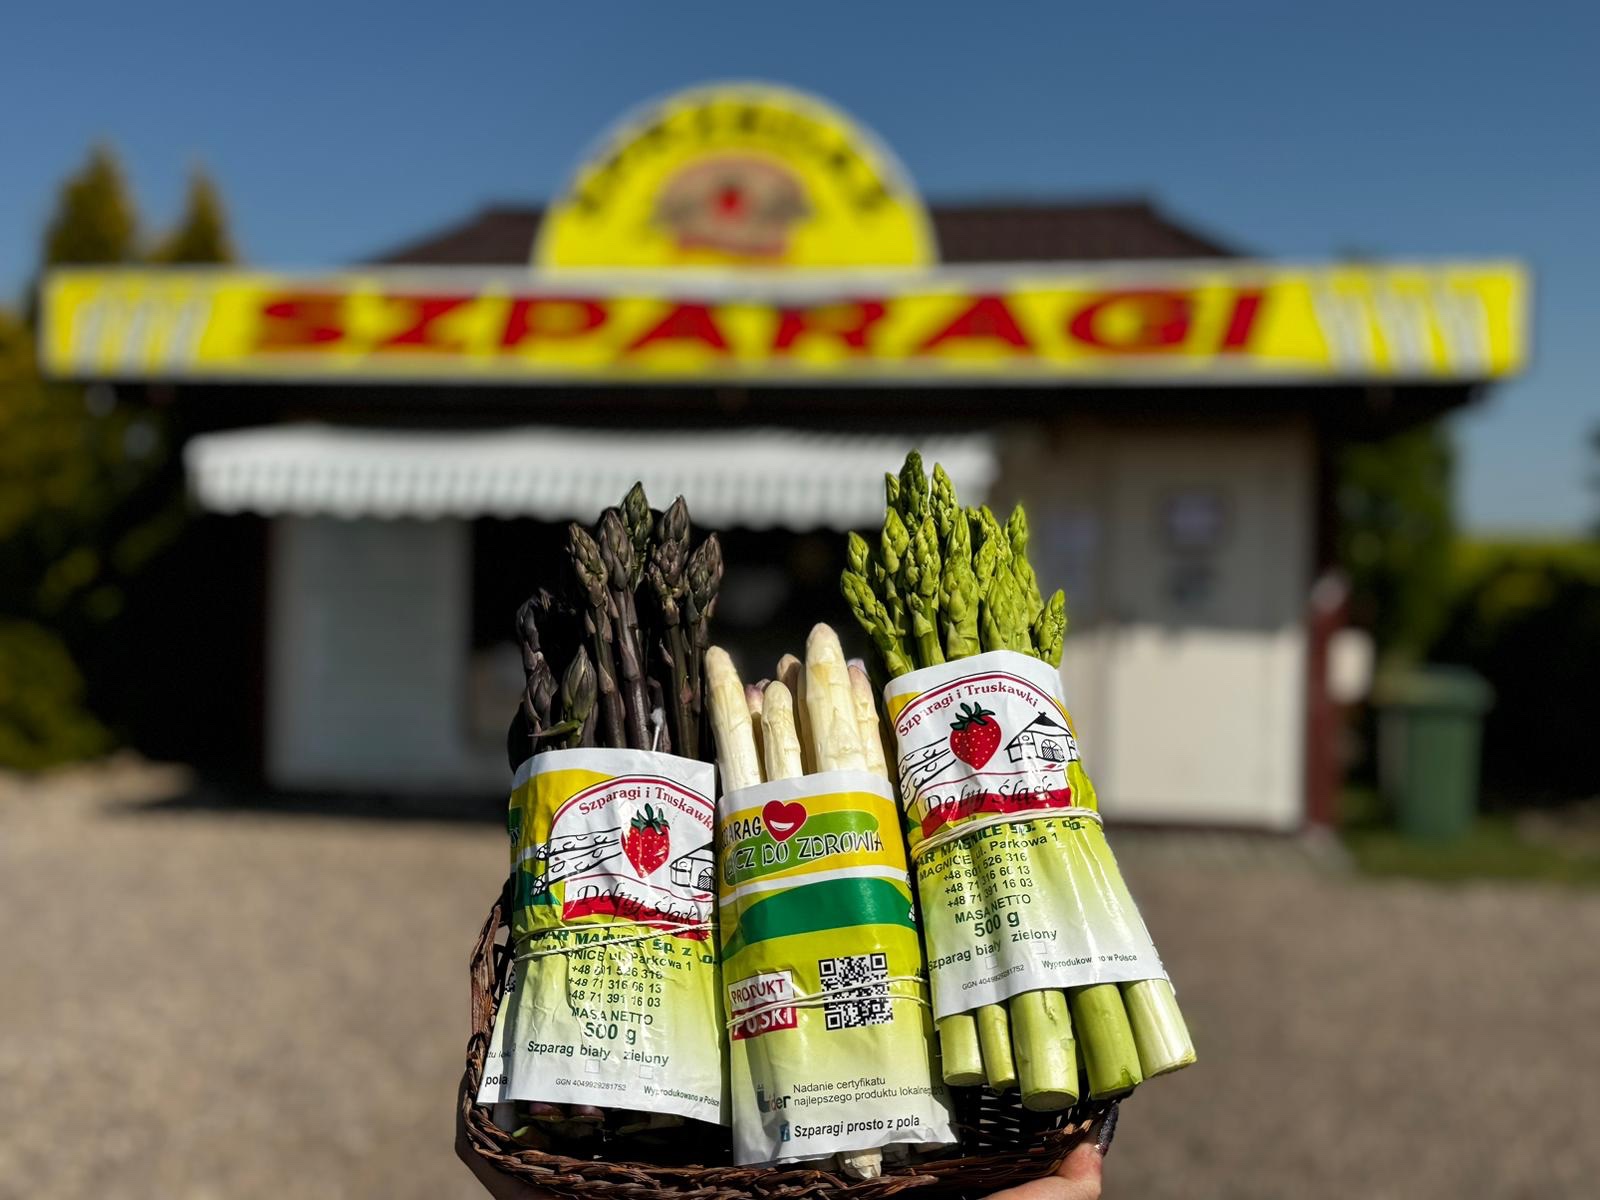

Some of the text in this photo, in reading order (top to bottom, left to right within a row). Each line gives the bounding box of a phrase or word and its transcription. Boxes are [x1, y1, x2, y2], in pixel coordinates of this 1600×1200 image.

[250, 287, 1266, 352] SZPARAGI
[956, 689, 962, 699] i
[964, 682, 1039, 708] Truskawki
[578, 786, 641, 815] Szparagi
[645, 786, 650, 799] i
[762, 841, 789, 867] DO
[796, 830, 885, 860] ZDROWIA
[919, 855, 972, 881] MAGNICE
[989, 835, 1048, 851] Parkowa
[1051, 832, 1058, 841] 1
[943, 870, 962, 881] +48
[983, 854, 1002, 870] 526
[1005, 852, 1028, 862] 316
[944, 882, 964, 895] +48
[967, 880, 980, 891] 71
[1016, 865, 1031, 875] 13
[947, 877, 1034, 908] +48 71 391 16 03
[954, 893, 1032, 924] MASA NETTO
[974, 911, 1021, 938] 500 g
[1011, 929, 1058, 943] zielony
[631, 952, 682, 970] Parkowa
[685, 961, 692, 971] 1
[681, 947, 692, 957] z
[1113, 953, 1138, 962] Polsce
[571, 964, 591, 975] +48
[641, 968, 663, 980] 316
[568, 977, 588, 987] +48
[592, 978, 603, 989] 71
[608, 979, 628, 990] 316
[648, 983, 662, 994] 13
[730, 978, 786, 1005] PRODUKT
[589, 991, 601, 1003] 71
[606, 993, 625, 1004] 391
[647, 996, 661, 1008] 03
[571, 1007, 654, 1026] MASA NETTO
[583, 1022, 637, 1045] 500 g
[527, 1040, 670, 1067] Szparag biały zielony
[484, 1073, 509, 1088] pola
[555, 1077, 572, 1086] GGN
[793, 1077, 886, 1094] Nadanie certyfikatu
[794, 1092, 853, 1108] najlepszego
[855, 1086, 897, 1104] produktu
[794, 1120, 844, 1139] Szparagi
[846, 1119, 884, 1136] prosto
[886, 1119, 893, 1129] z
[896, 1114, 920, 1132] pola
